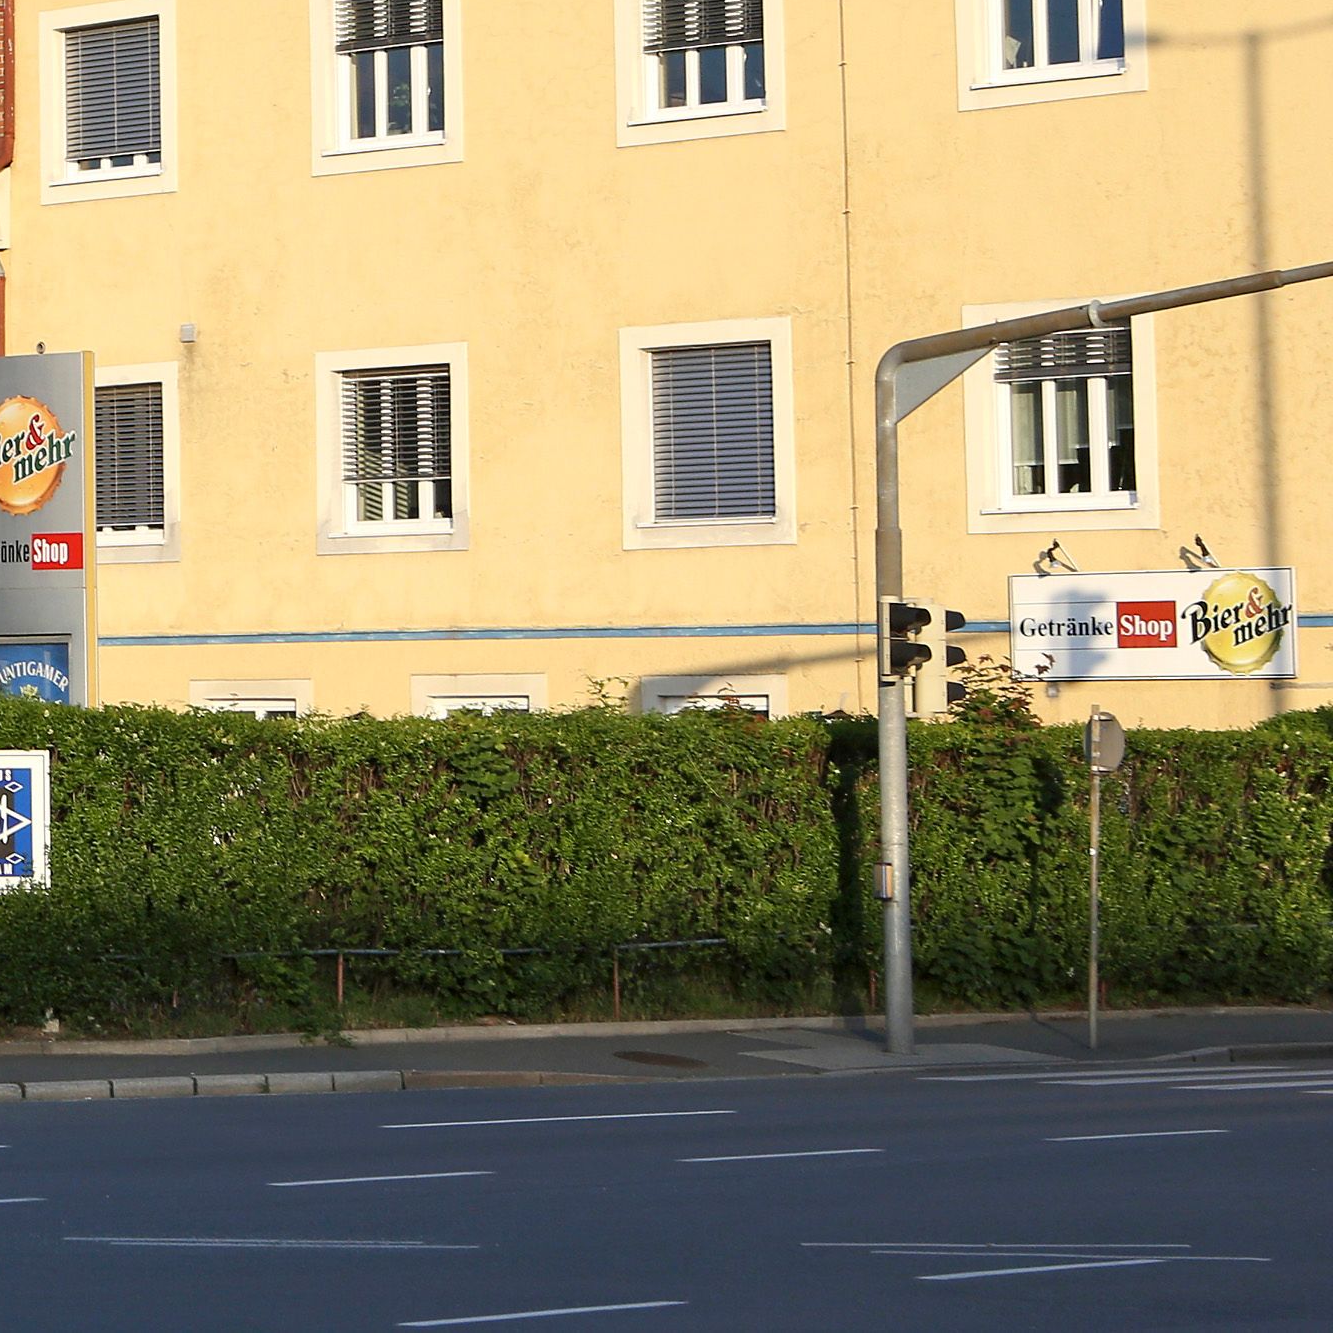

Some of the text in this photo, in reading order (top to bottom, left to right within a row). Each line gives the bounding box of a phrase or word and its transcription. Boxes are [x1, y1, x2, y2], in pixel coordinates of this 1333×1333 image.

[26, 414, 45, 451] &
[13, 431, 76, 483] mehr
[34, 539, 68, 564] Shop
[1019, 614, 1173, 642] Getränke Shop
[1182, 586, 1264, 645] Bier &
[1234, 602, 1293, 647] mehr
